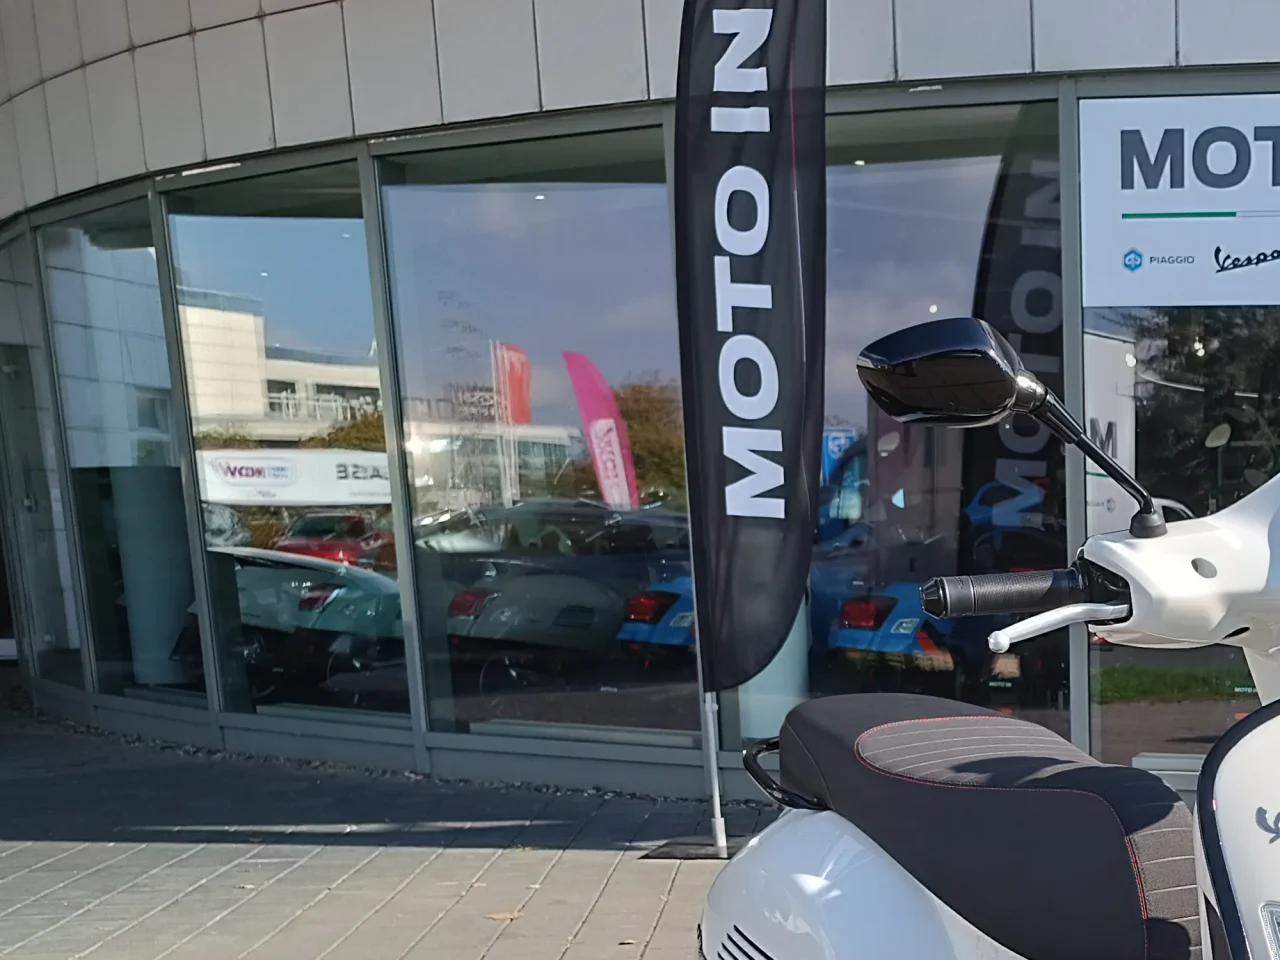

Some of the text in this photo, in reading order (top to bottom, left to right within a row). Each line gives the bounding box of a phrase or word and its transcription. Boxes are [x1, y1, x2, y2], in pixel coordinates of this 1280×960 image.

[710, 7, 786, 519] MOTO IN
[1149, 255, 1195, 265] PIAGGIO
